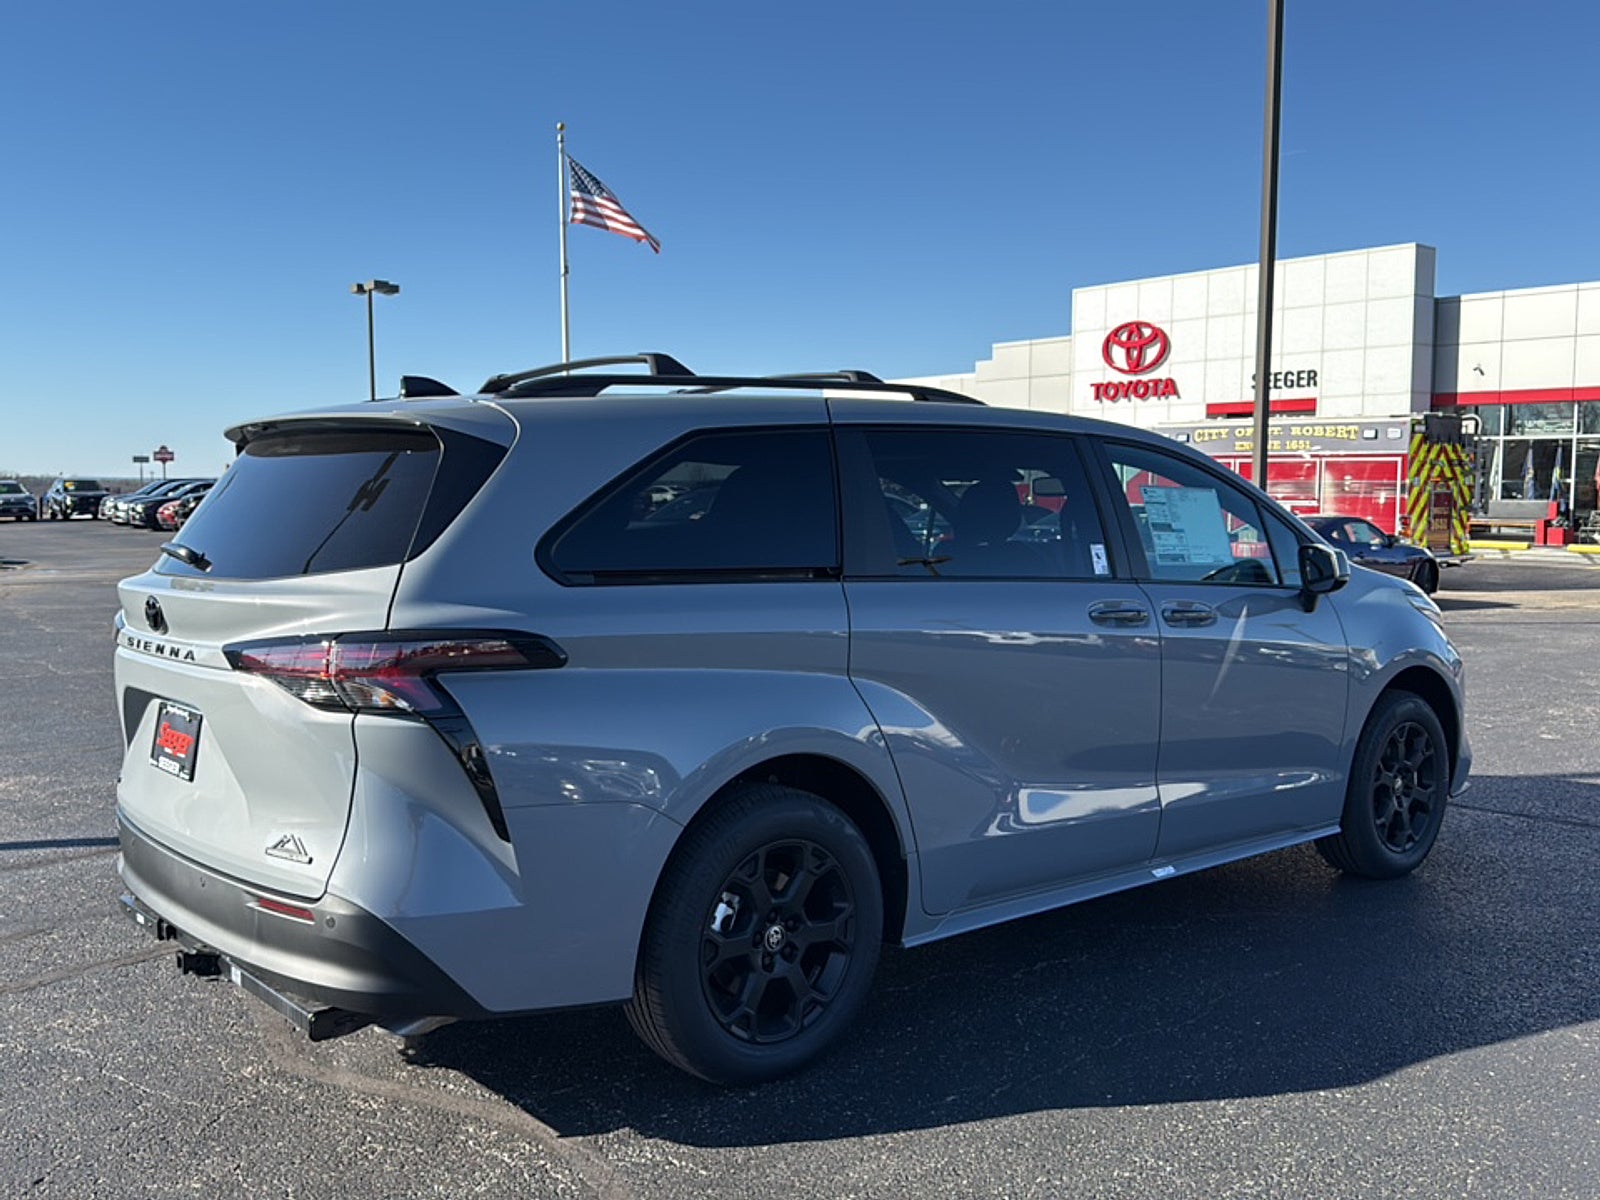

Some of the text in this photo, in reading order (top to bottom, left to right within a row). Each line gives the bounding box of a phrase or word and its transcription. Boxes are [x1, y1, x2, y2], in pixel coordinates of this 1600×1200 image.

[1092, 377, 1178, 401] TOYOTA
[1251, 369, 1318, 390] EGER
[1194, 428, 1229, 443] CITY
[1290, 425, 1359, 440] ROBERT
[127, 636, 196, 662] SIENNA
